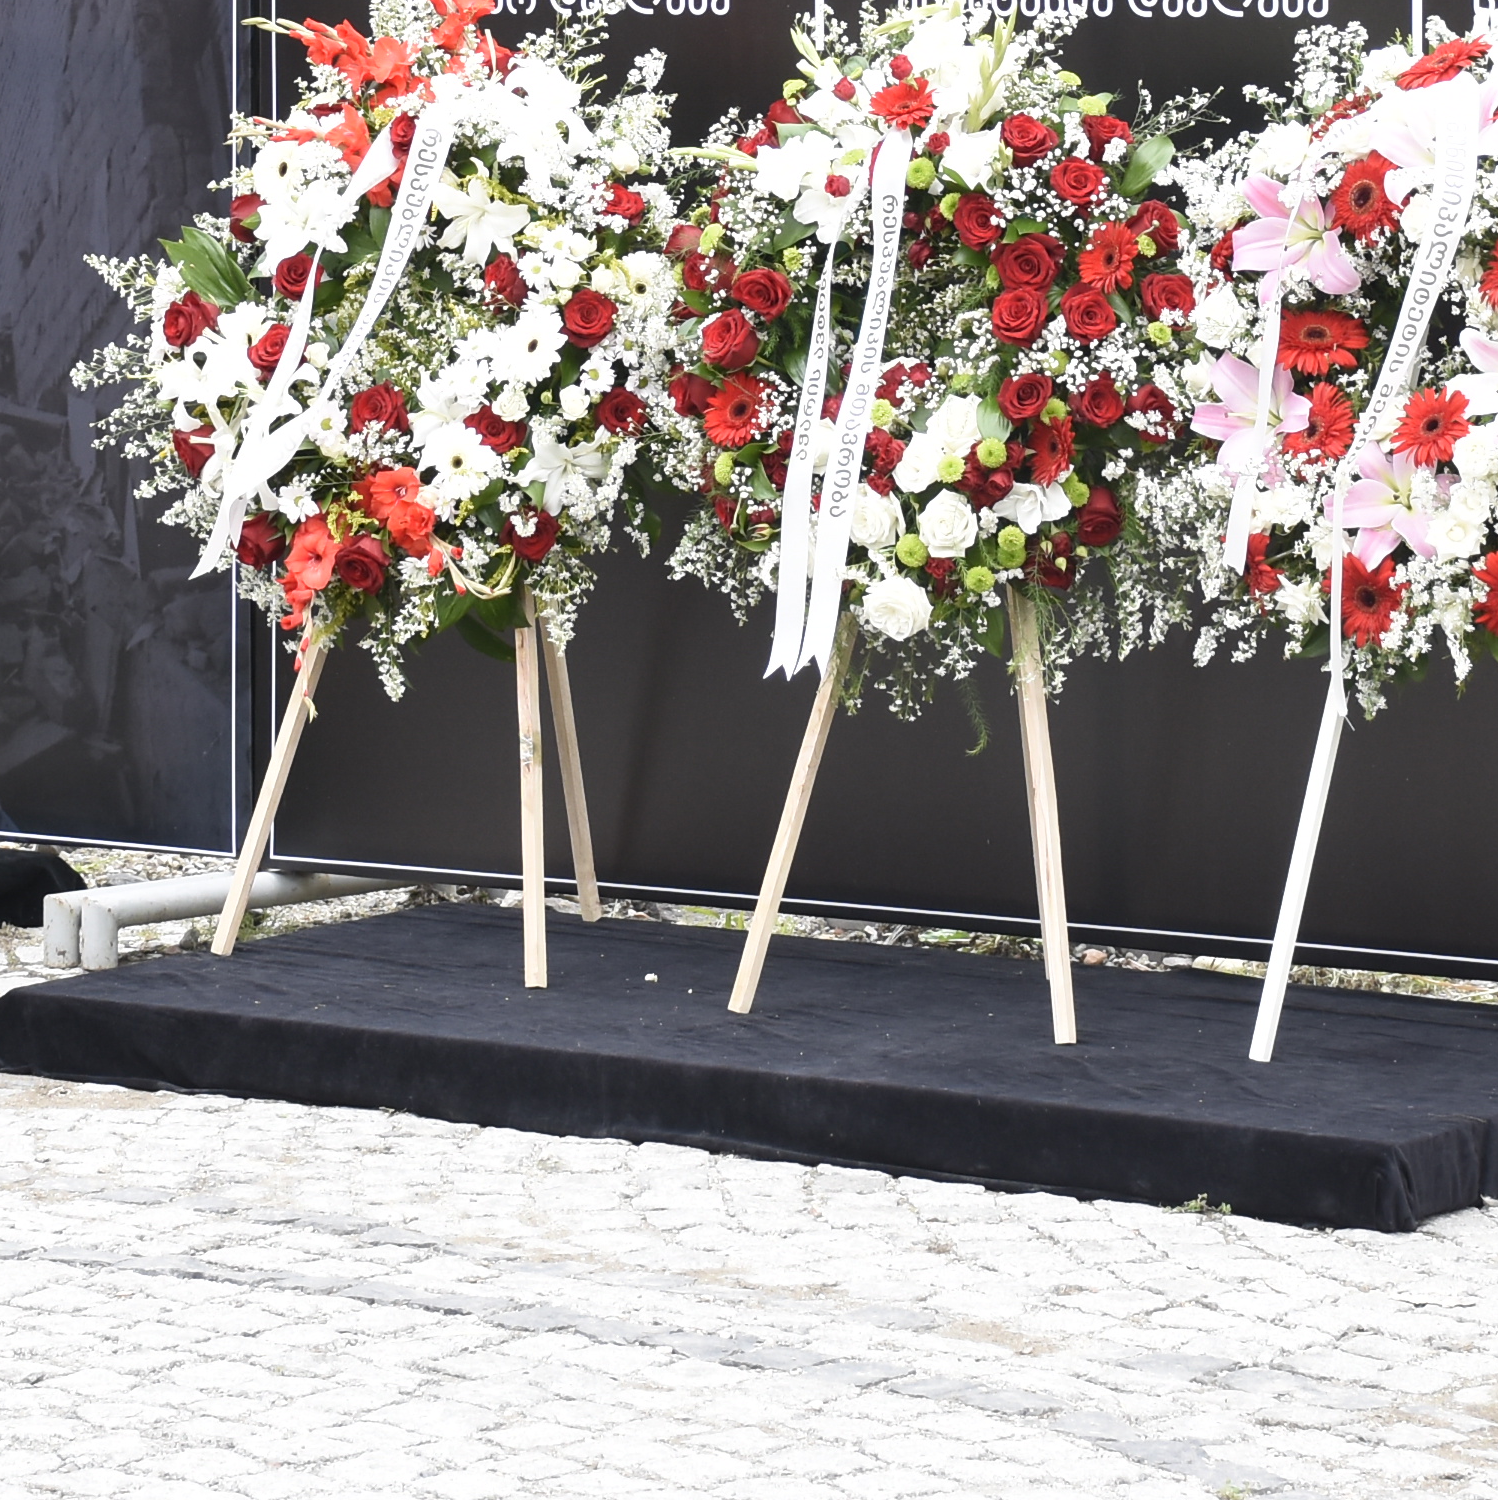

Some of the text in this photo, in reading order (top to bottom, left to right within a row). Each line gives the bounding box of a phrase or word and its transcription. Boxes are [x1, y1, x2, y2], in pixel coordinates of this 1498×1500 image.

[373, 127, 443, 306] რესპუბლიკის
[795, 368, 822, 461] აჭარის
[829, 193, 899, 518] რესპუბლიკის მთავრობა
